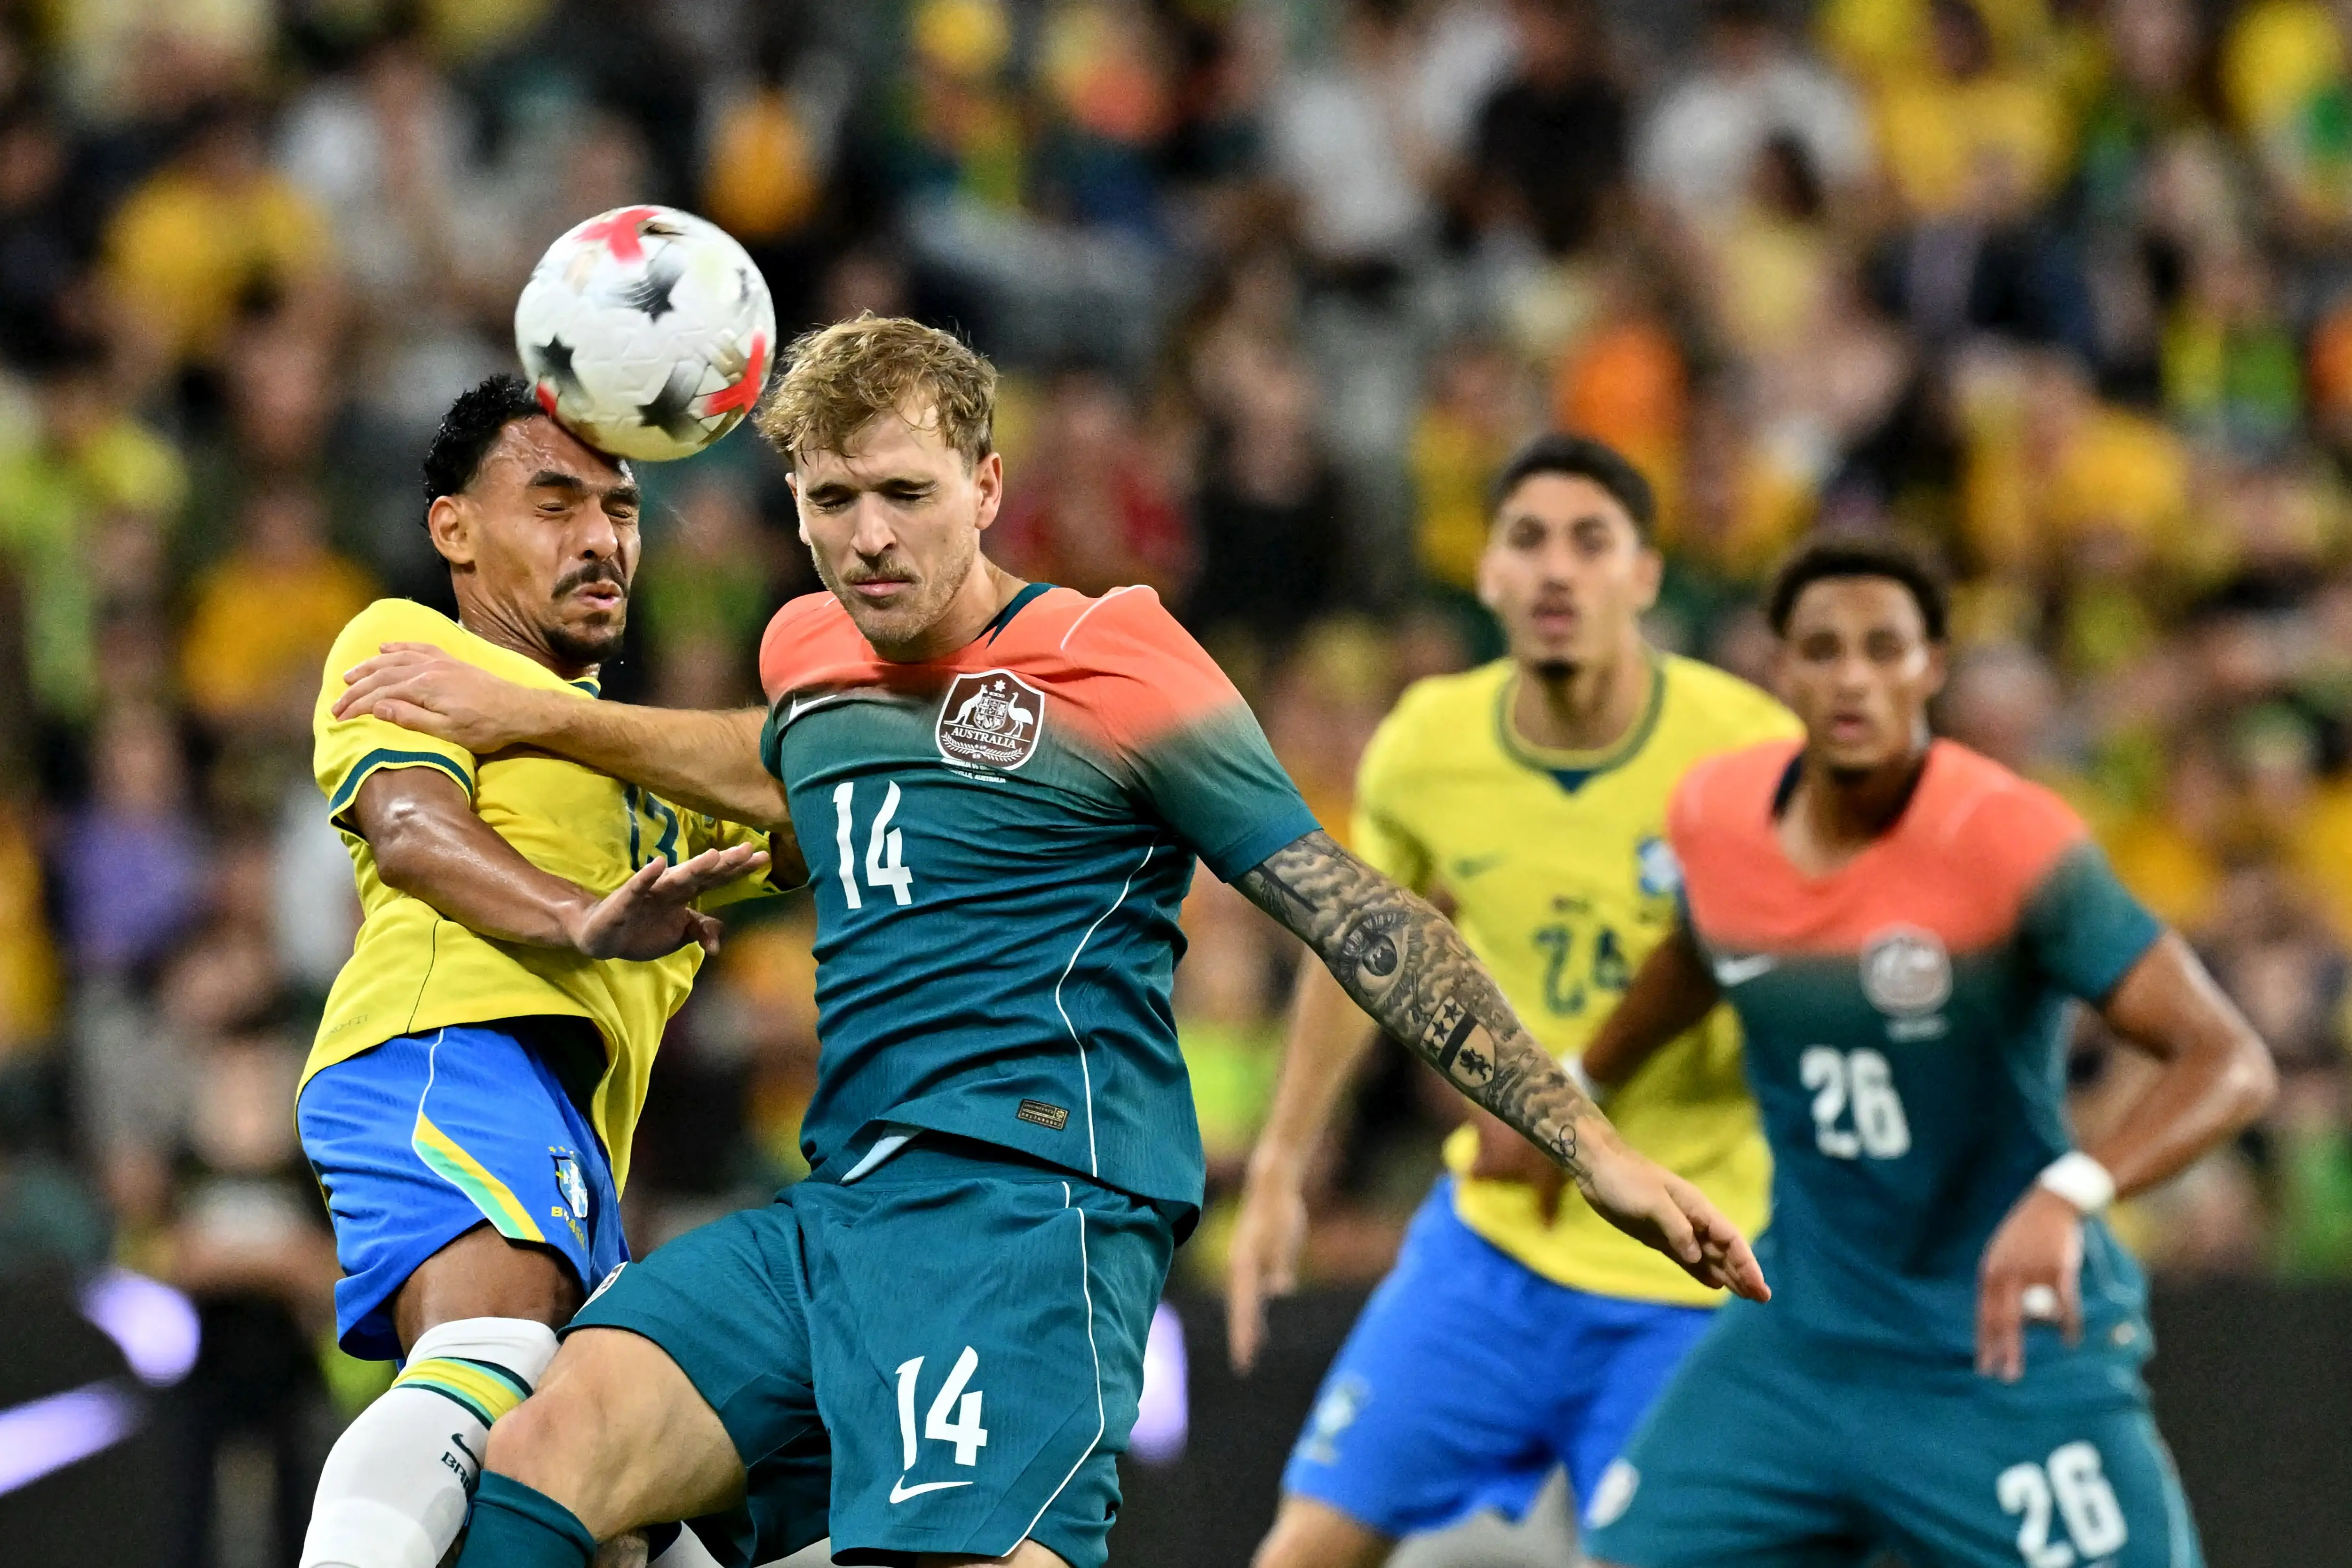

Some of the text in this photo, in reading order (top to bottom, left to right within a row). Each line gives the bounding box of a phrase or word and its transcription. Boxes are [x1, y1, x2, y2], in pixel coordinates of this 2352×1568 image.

[951, 727, 1016, 749] AUSTRALIA
[626, 783, 679, 872] 13
[833, 780, 913, 909] 14
[1799, 1045, 1911, 1159] 26
[895, 1346, 988, 1471] 14
[1997, 1441, 2127, 1568] 26
